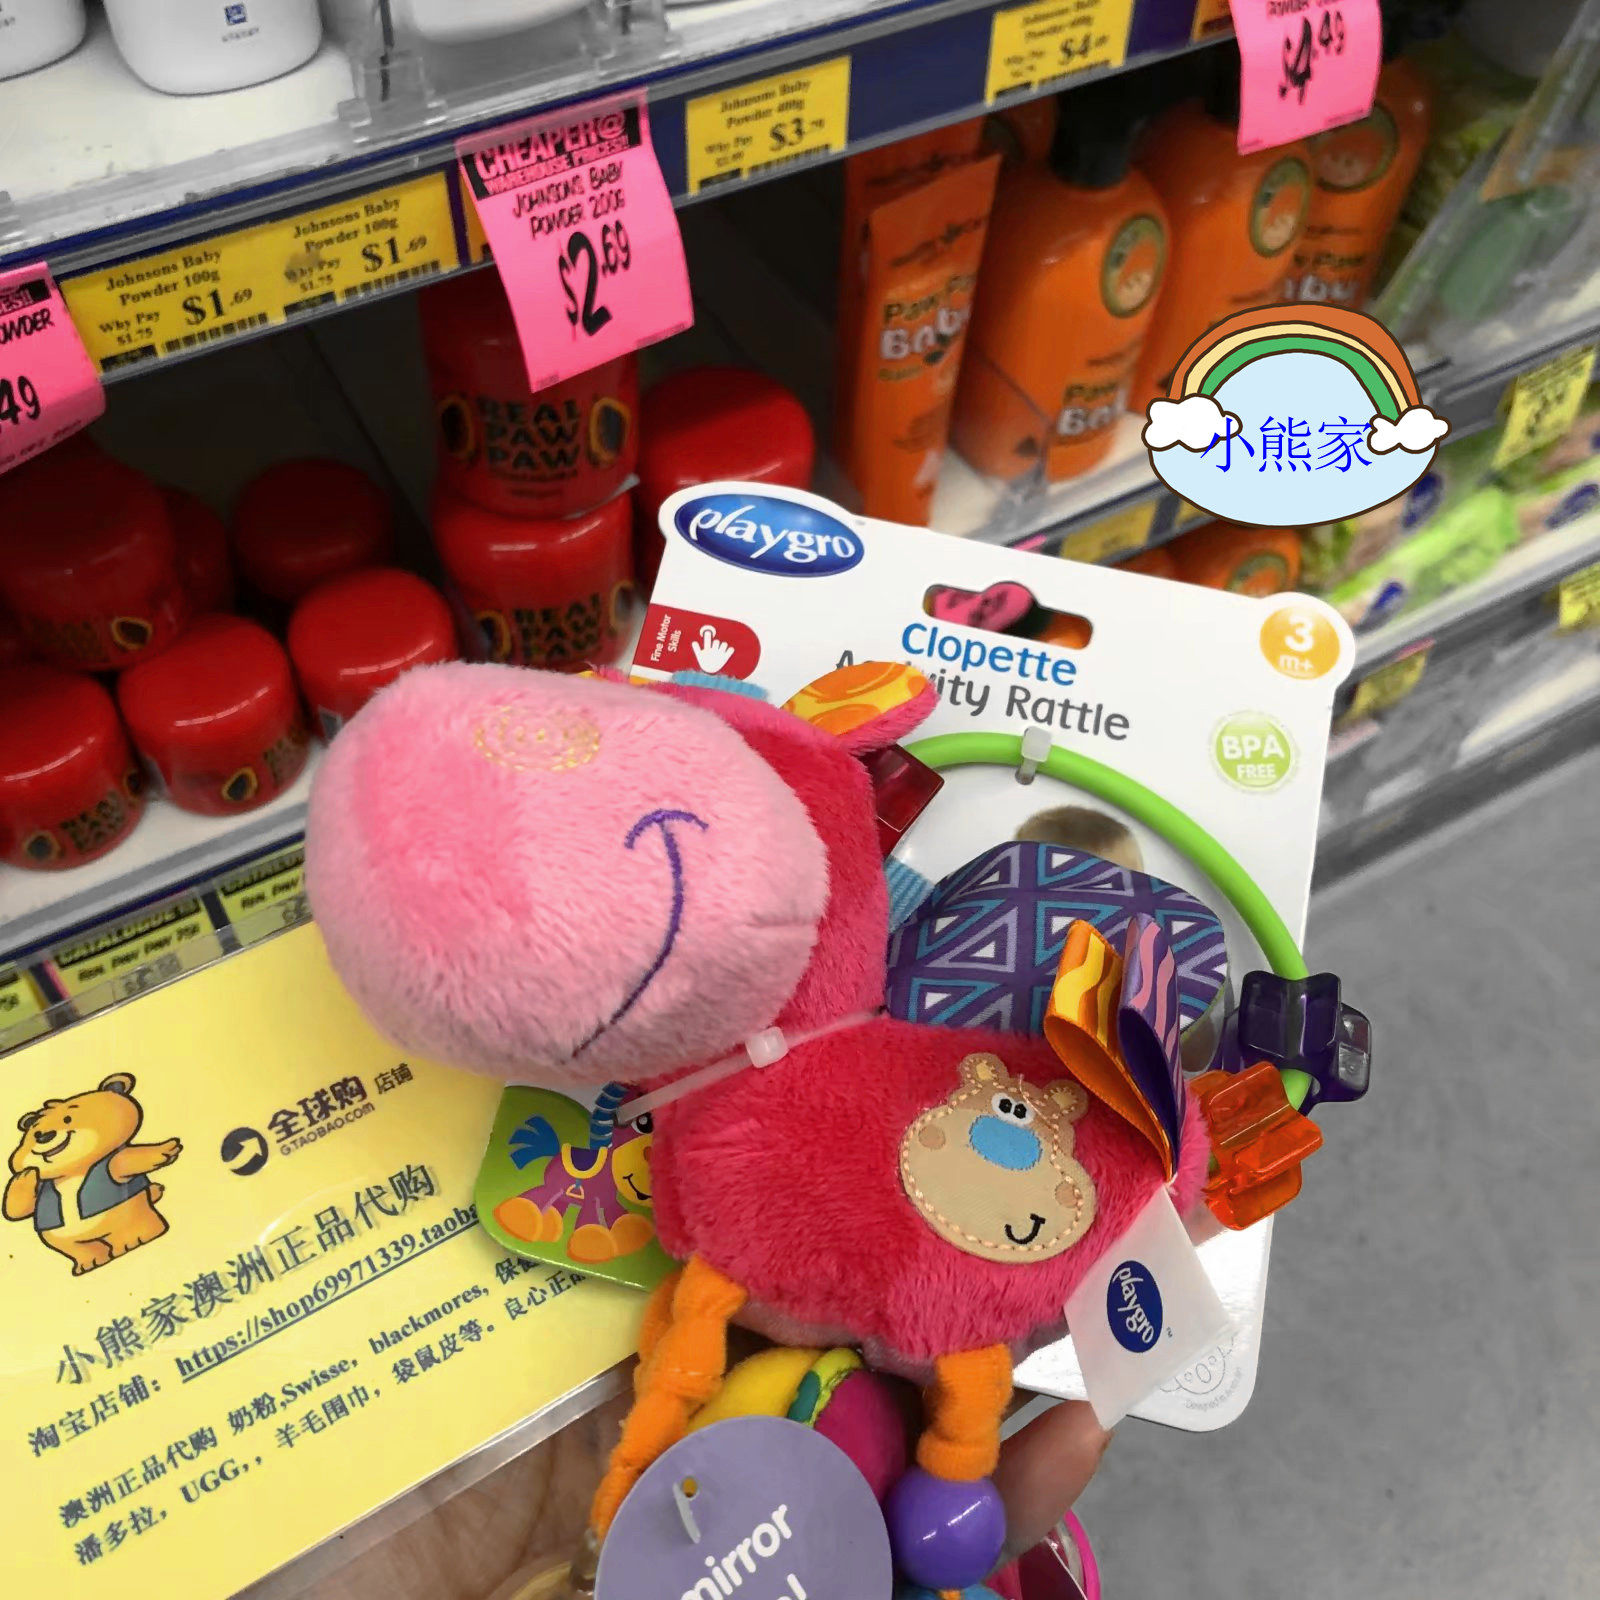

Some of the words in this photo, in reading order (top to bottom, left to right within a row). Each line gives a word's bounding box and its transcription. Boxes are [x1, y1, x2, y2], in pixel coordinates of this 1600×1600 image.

[105, 262, 179, 292] Johnsons
[181, 249, 223, 270] Baby
[118, 280, 180, 307] Powder
[183, 269, 222, 289] 100g
[688, 504, 856, 564] playgro
[650, 632, 665, 663] Fine
[656, 613, 672, 644] Motor
[667, 629, 682, 653] Skills
[1284, 614, 1315, 653] 3
[901, 621, 1078, 686] Clopette
[1278, 653, 1314, 672] m+
[1004, 684, 1131, 741] Rattle
[1221, 734, 1285, 760] BPA
[1236, 763, 1277, 779] FREE
[267, 1075, 368, 1143] 全球购
[373, 1062, 414, 1095] 店铺
[55, 1163, 437, 1386] 小熊家澳洲正品代购
[1111, 1266, 1155, 1345] playgro
[58, 1425, 219, 1529] 澳洲正品代购
